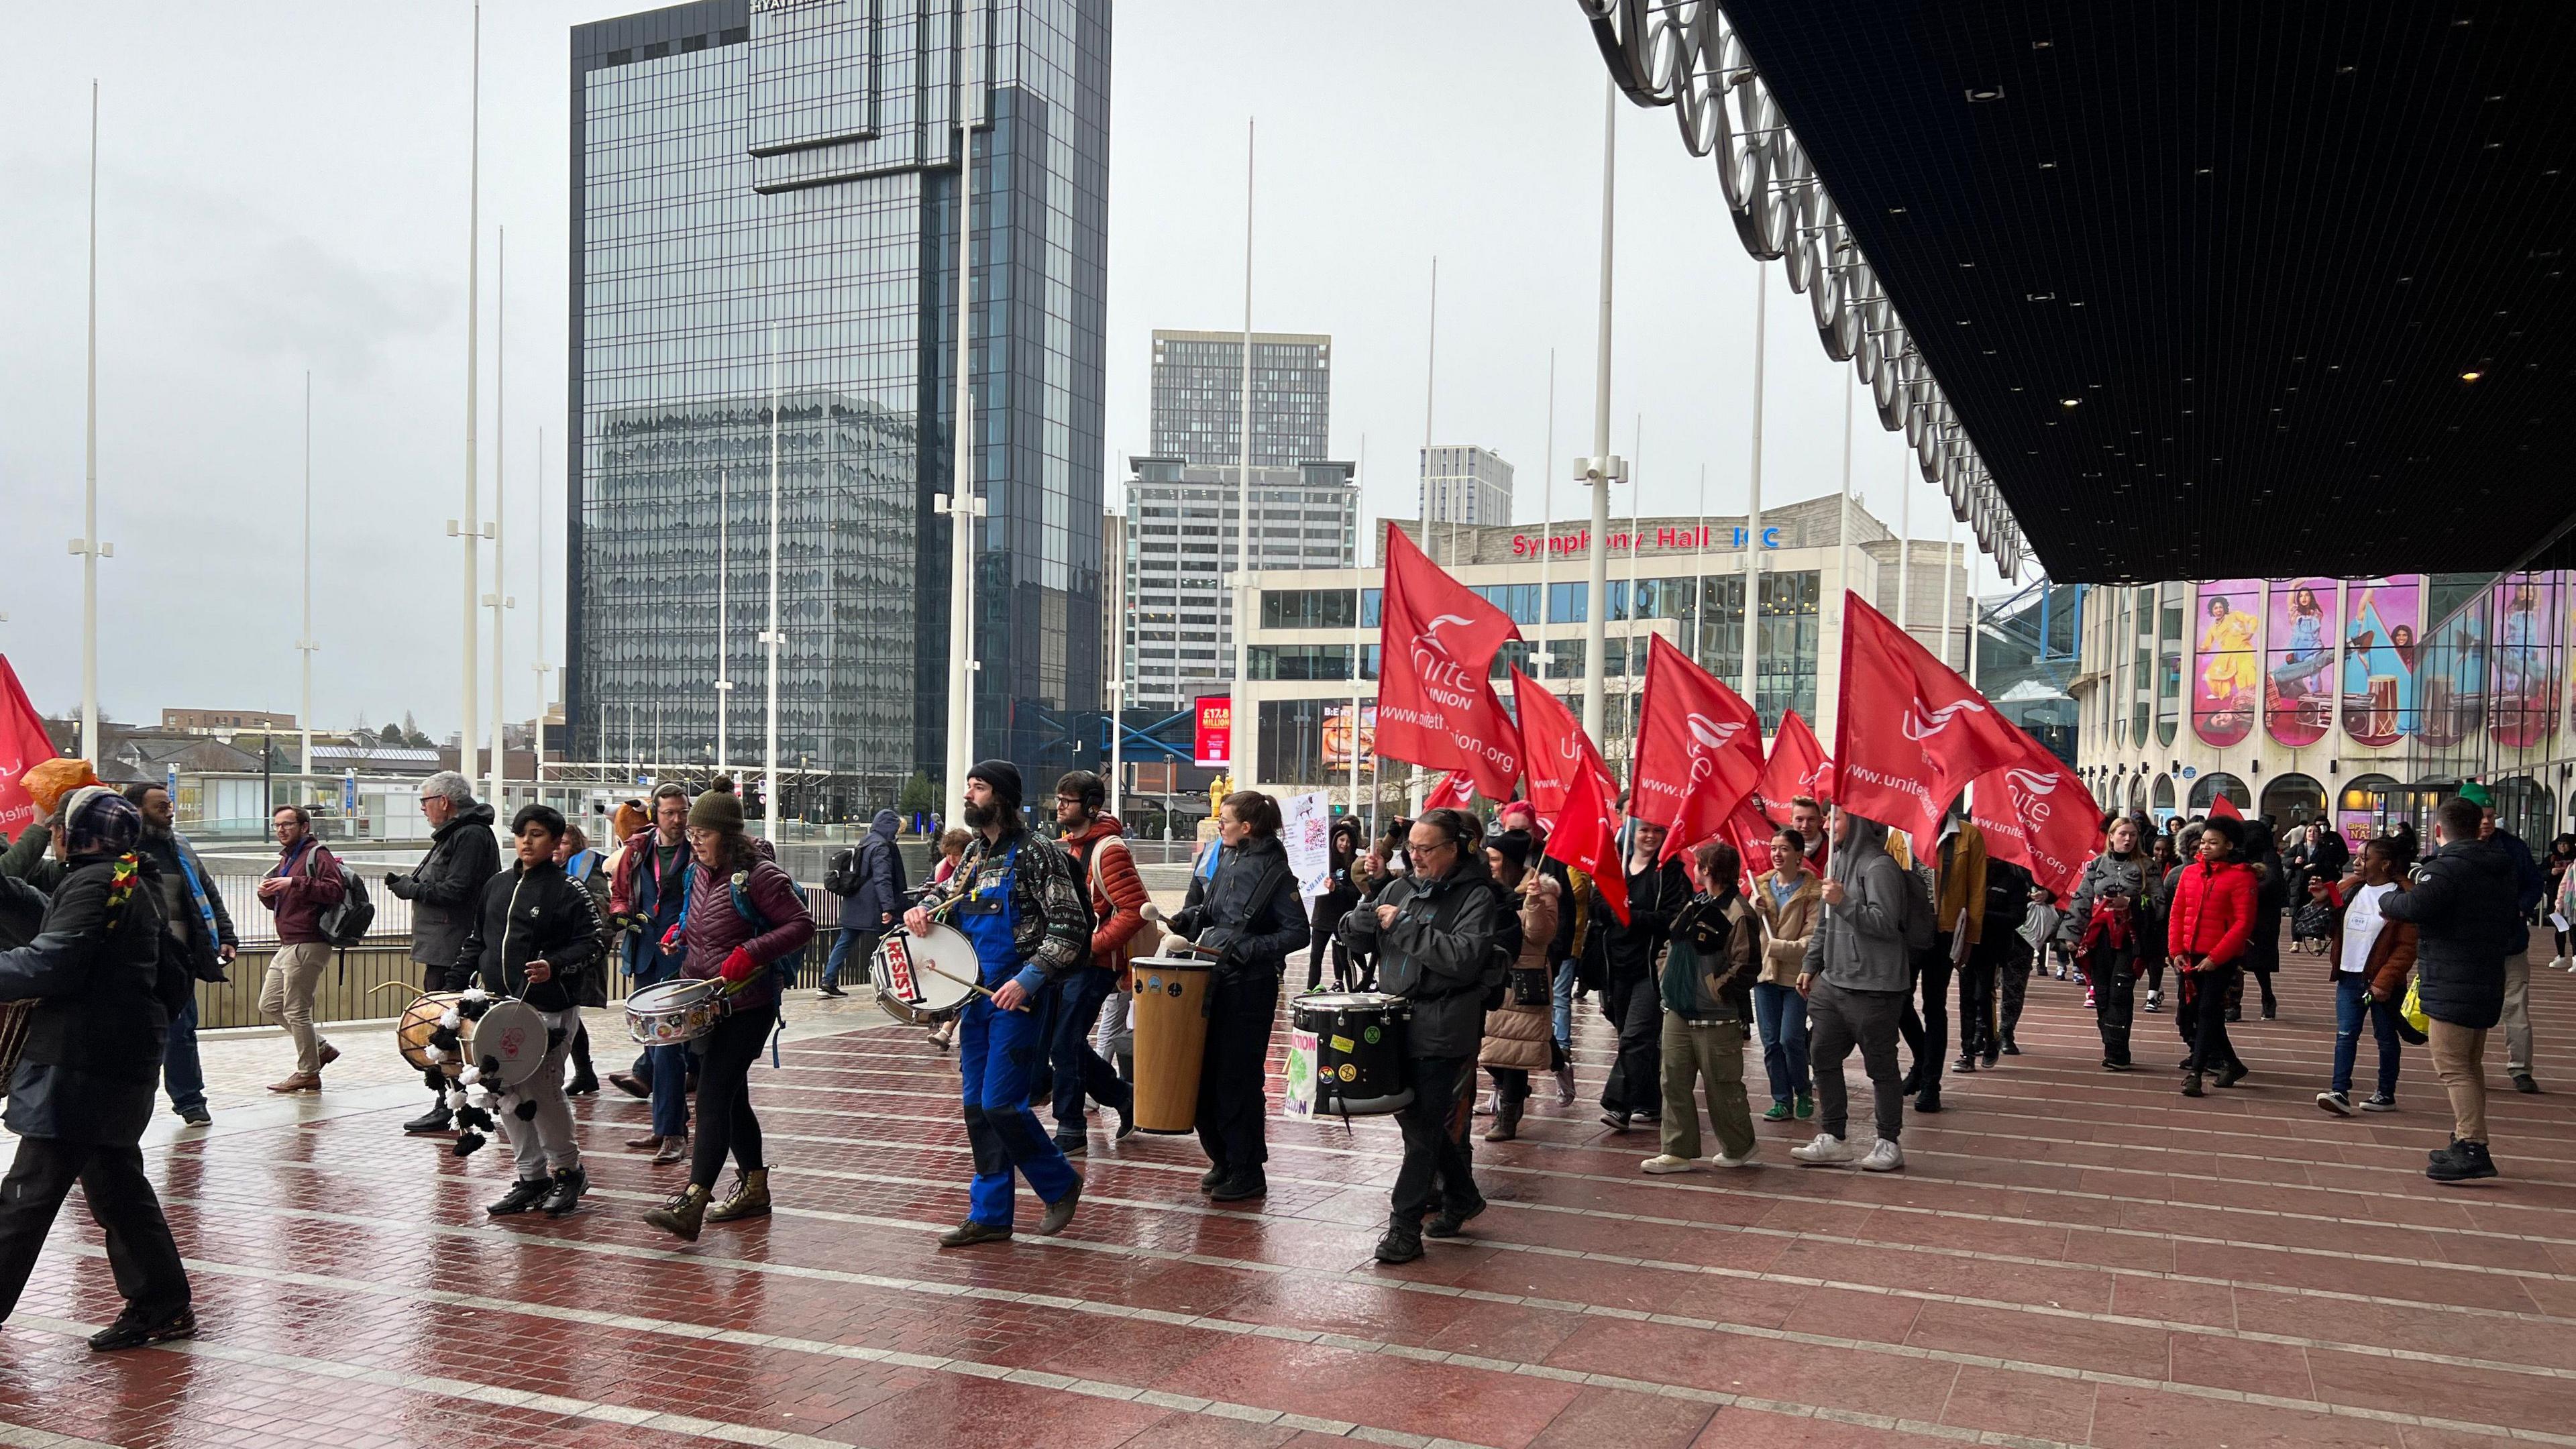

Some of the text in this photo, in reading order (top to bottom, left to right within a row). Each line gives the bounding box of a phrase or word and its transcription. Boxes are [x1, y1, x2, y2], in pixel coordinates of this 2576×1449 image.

[1512, 525, 1709, 559] Symphny Hall
[1202, 718, 1230, 728] MILLION
[1203, 708, 1230, 719] £17.8
[885, 941, 914, 1000] RESIST
